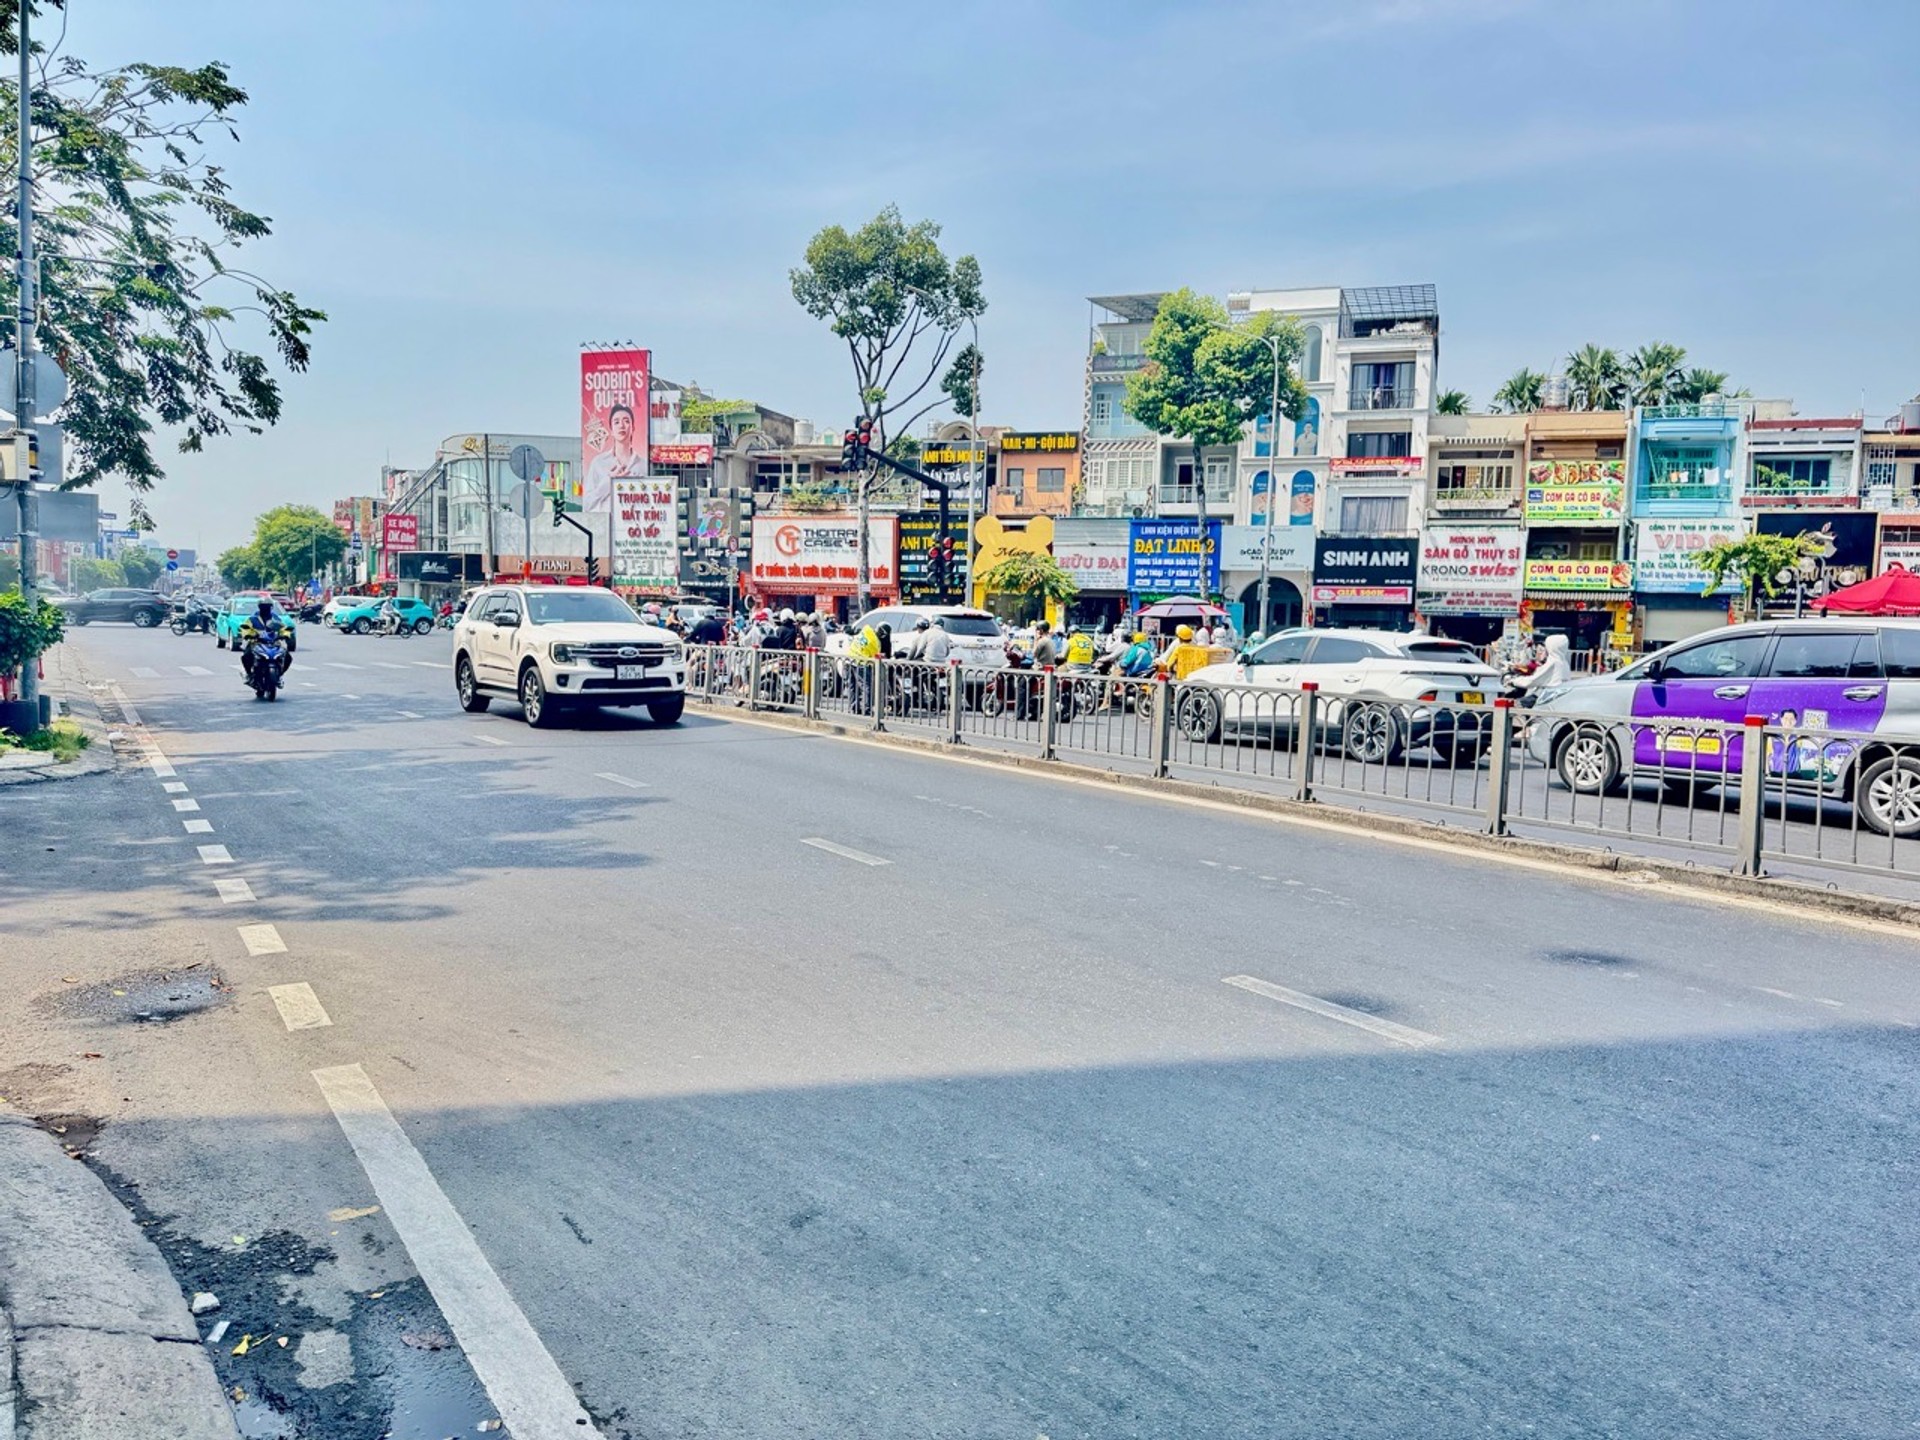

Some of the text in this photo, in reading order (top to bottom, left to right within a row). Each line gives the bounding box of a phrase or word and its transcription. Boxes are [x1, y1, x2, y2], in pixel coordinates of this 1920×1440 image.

[585, 370, 644, 391] SOOBIN'S
[594, 390, 635, 412] QUEEN
[963, 470, 982, 482] GP
[618, 490, 671, 504] TRUNG TÂM
[387, 519, 397, 528] XE
[1134, 538, 1215, 556] ĐẠT LINH 2
[1424, 545, 1520, 561] SÀN GỖ THỤY SĨ
[541, 559, 571, 571] THANH
[1059, 554, 1126, 571] HỮU ĐẠI
[1323, 550, 1410, 567] SINH ANH
